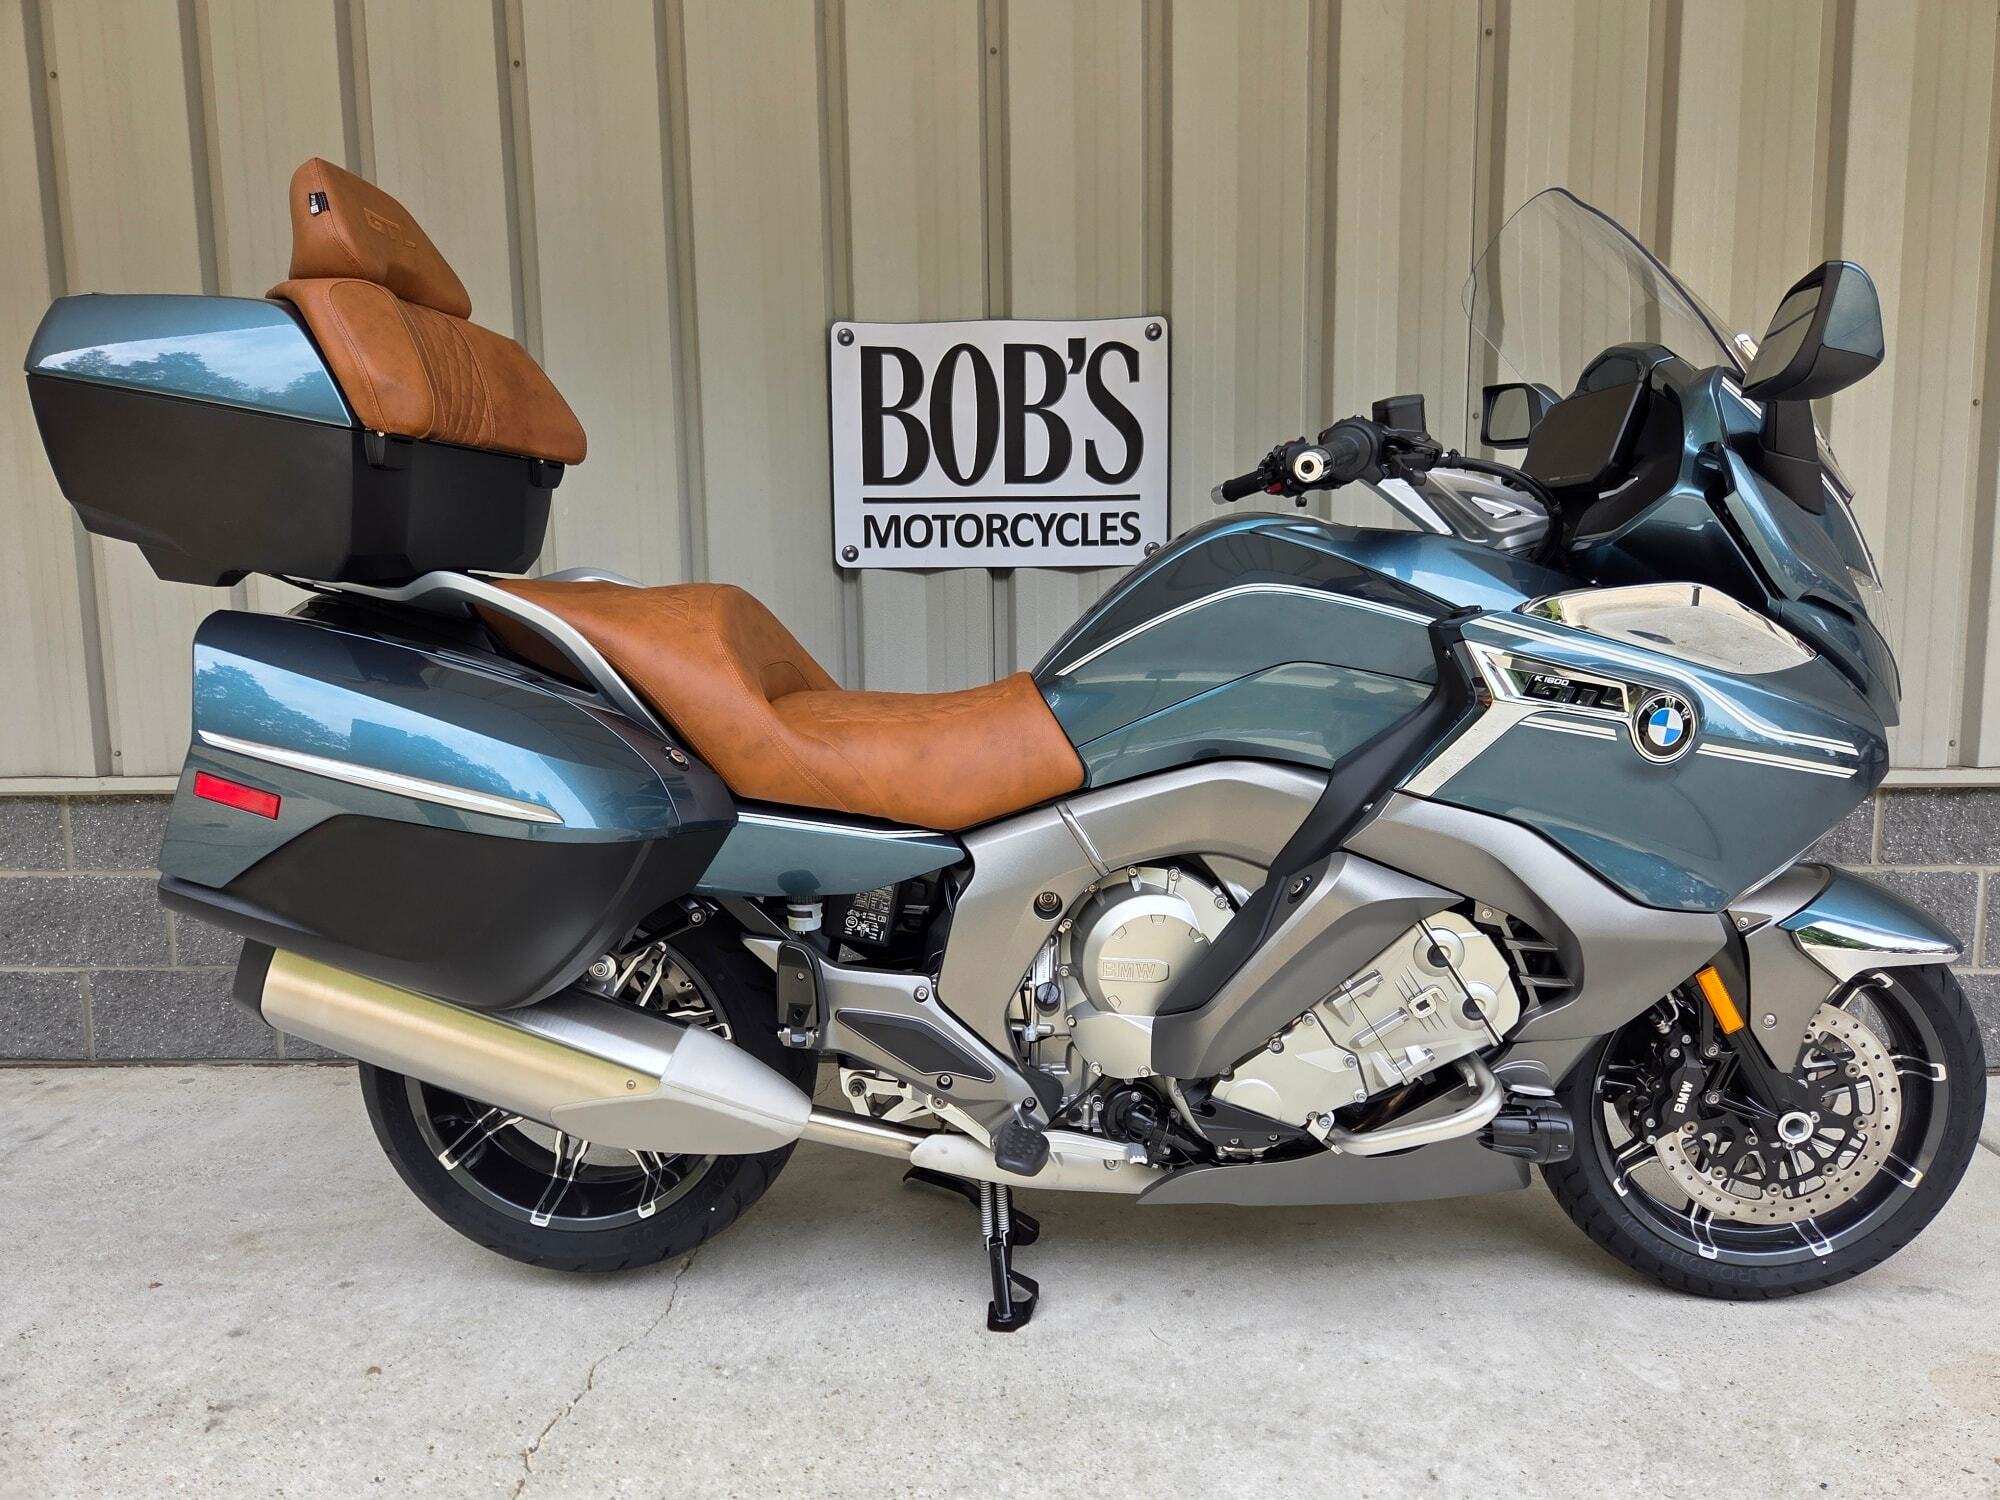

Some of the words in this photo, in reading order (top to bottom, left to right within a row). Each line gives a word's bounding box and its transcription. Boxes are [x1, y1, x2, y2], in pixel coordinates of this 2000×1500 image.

[860, 337, 1144, 487] BOB'S
[863, 511, 1141, 549] MOTORCYCLES
[1102, 962, 1156, 979] BMW
[1673, 1080, 1694, 1113] BMW
